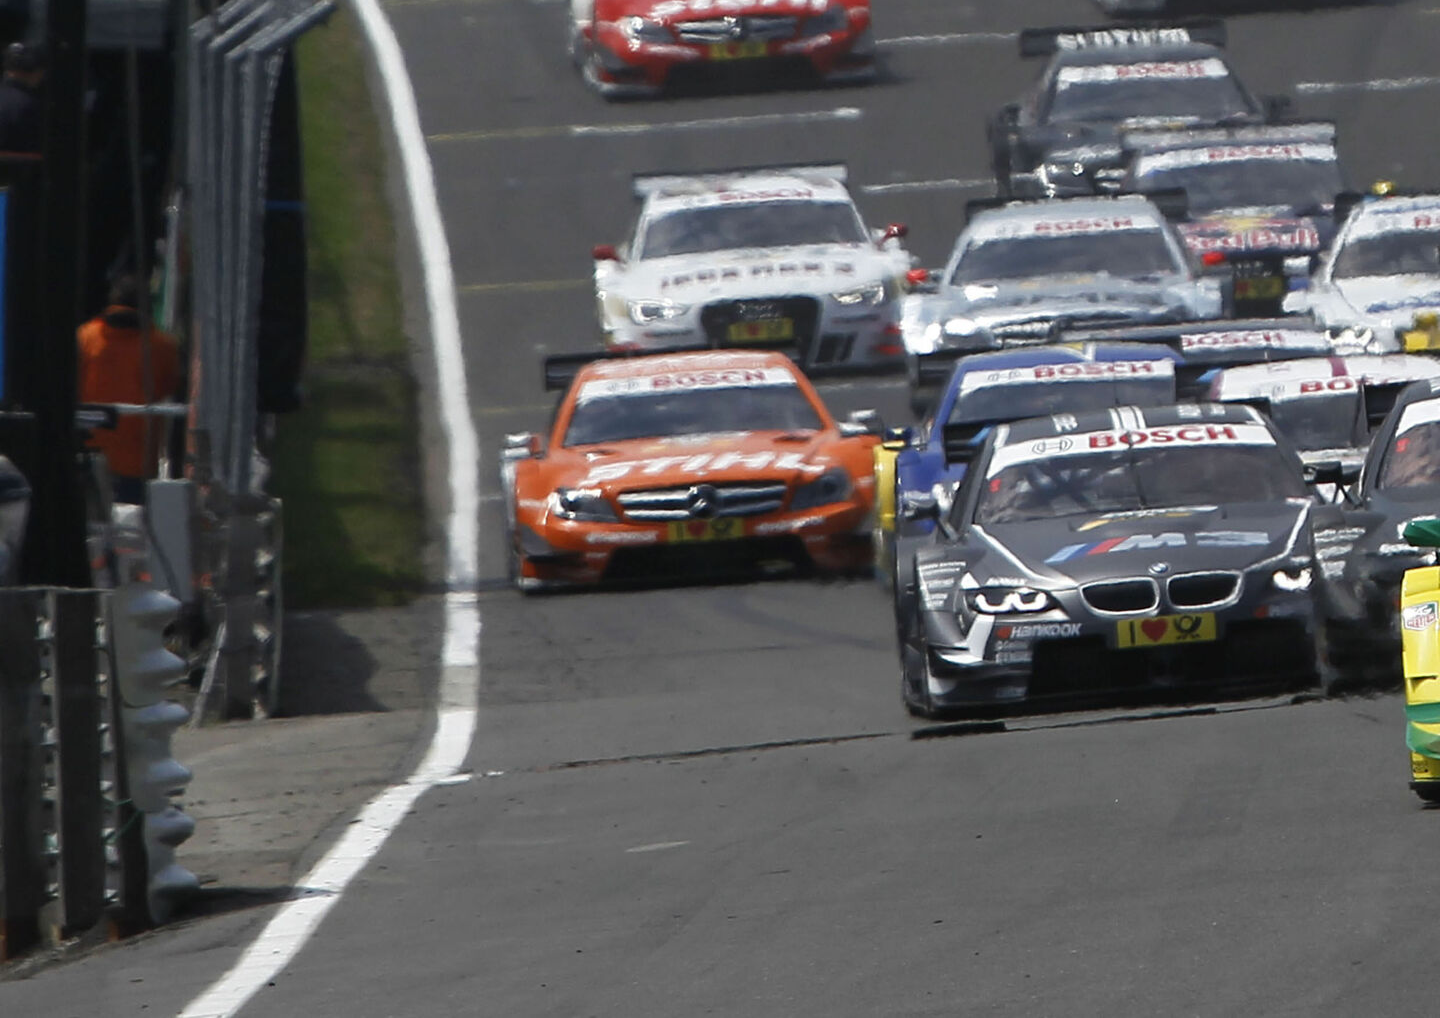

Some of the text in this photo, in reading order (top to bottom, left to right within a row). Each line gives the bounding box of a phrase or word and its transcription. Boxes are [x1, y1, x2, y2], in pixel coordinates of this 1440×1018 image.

[652, 370, 766, 390] BOSCH
[1034, 362, 1154, 379] BOSCH
[1089, 427, 1235, 449] BOSCH
[578, 451, 826, 488] STIHL
